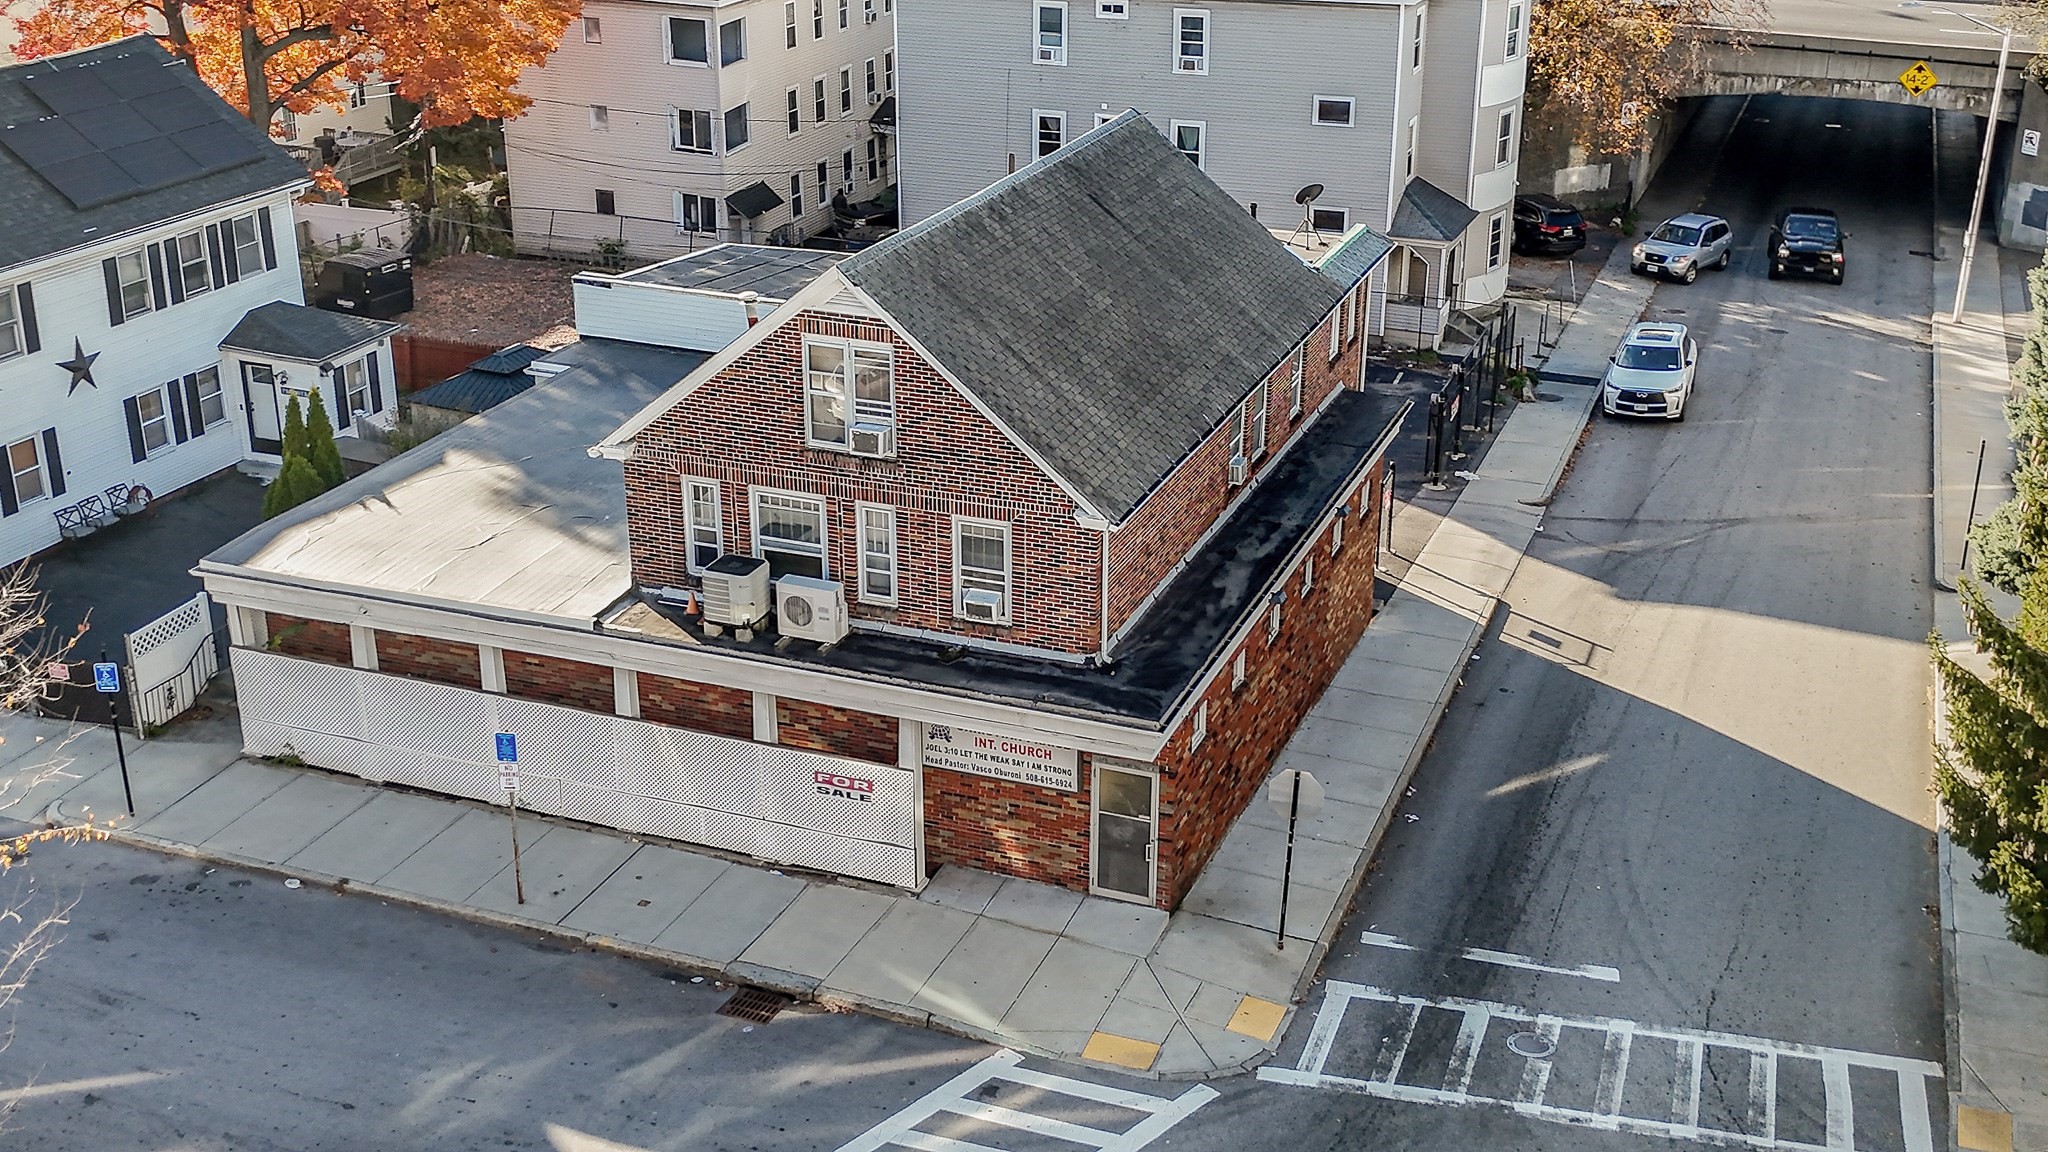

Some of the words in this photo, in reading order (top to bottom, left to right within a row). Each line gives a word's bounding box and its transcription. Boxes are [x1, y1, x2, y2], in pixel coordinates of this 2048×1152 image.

[974, 736, 997, 750] INT.
[1001, 741, 1052, 760] CHURCH
[925, 743, 942, 753] JOEL
[944, 746, 959, 756] 3:10
[960, 749, 972, 758] LET
[975, 751, 988, 761] THE
[990, 754, 1009, 765] WEAK
[1011, 758, 1025, 768] SAY
[1031, 762, 1042, 771] AM
[1043, 764, 1073, 777] STRONG
[925, 755, 942, 765] Head
[944, 758, 969, 769] Pastor:
[971, 763, 992, 774] Vasco
[817, 773, 871, 791] FOR
[816, 786, 872, 803] SALE
